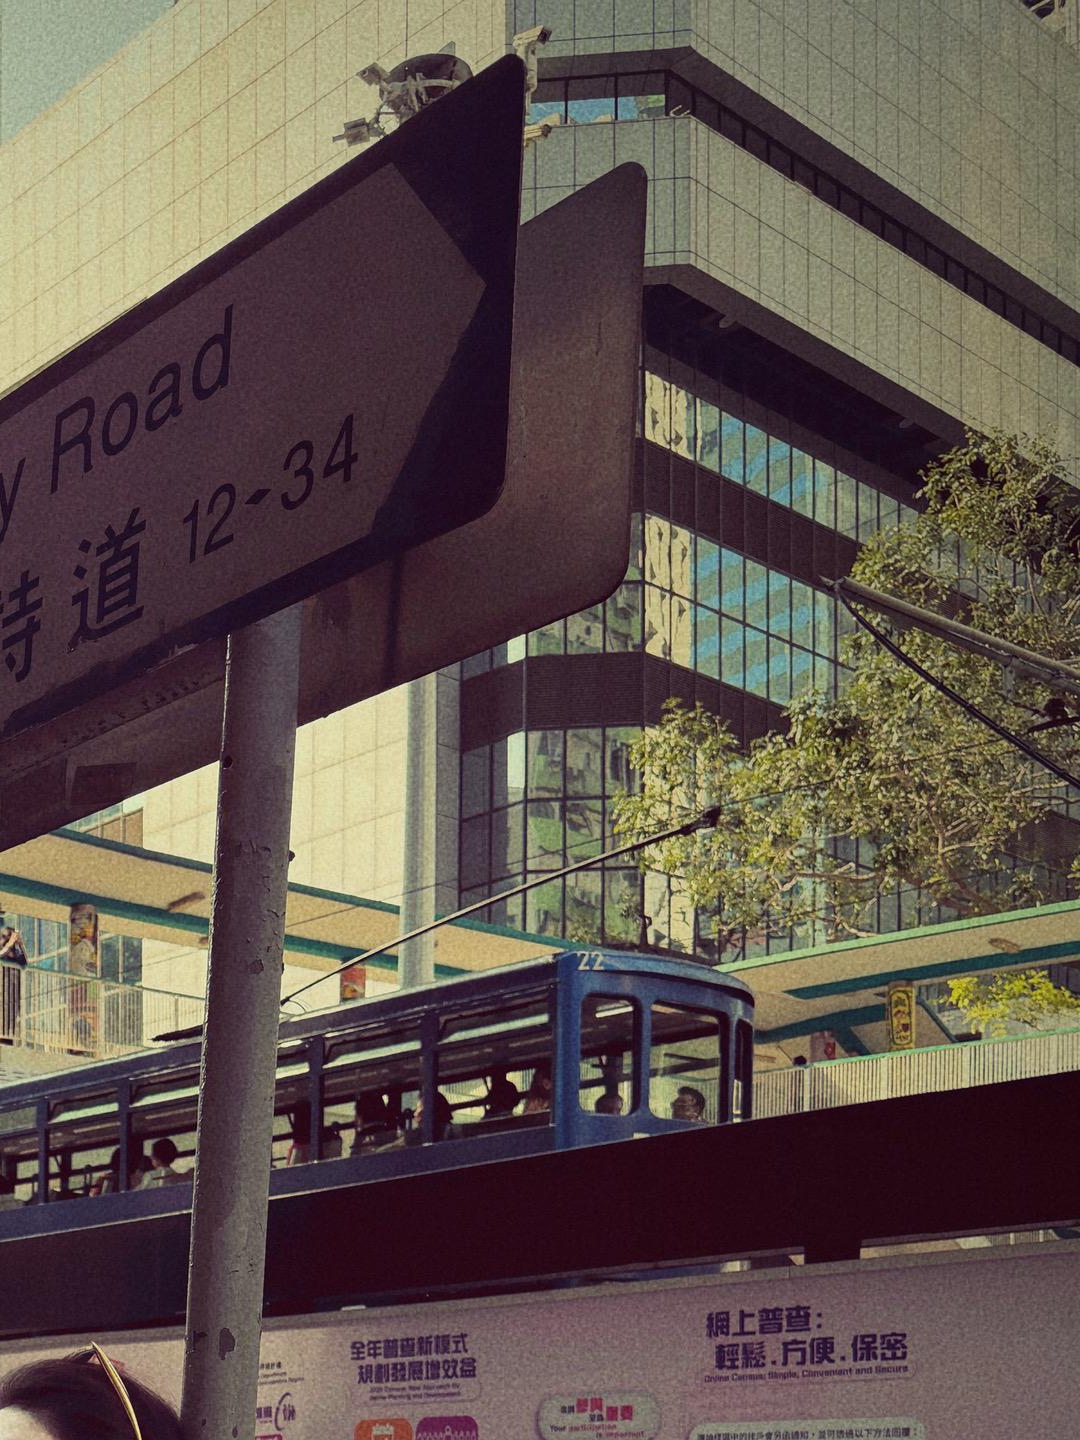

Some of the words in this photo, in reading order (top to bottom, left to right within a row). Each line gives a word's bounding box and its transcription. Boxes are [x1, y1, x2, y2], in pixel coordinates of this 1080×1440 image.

[50, 304, 233, 494] Road
[183, 413, 358, 564] 12-34
[350, 1333, 468, 1360] 全年普查新模式
[358, 1357, 476, 1384] 規劃發展增效益
